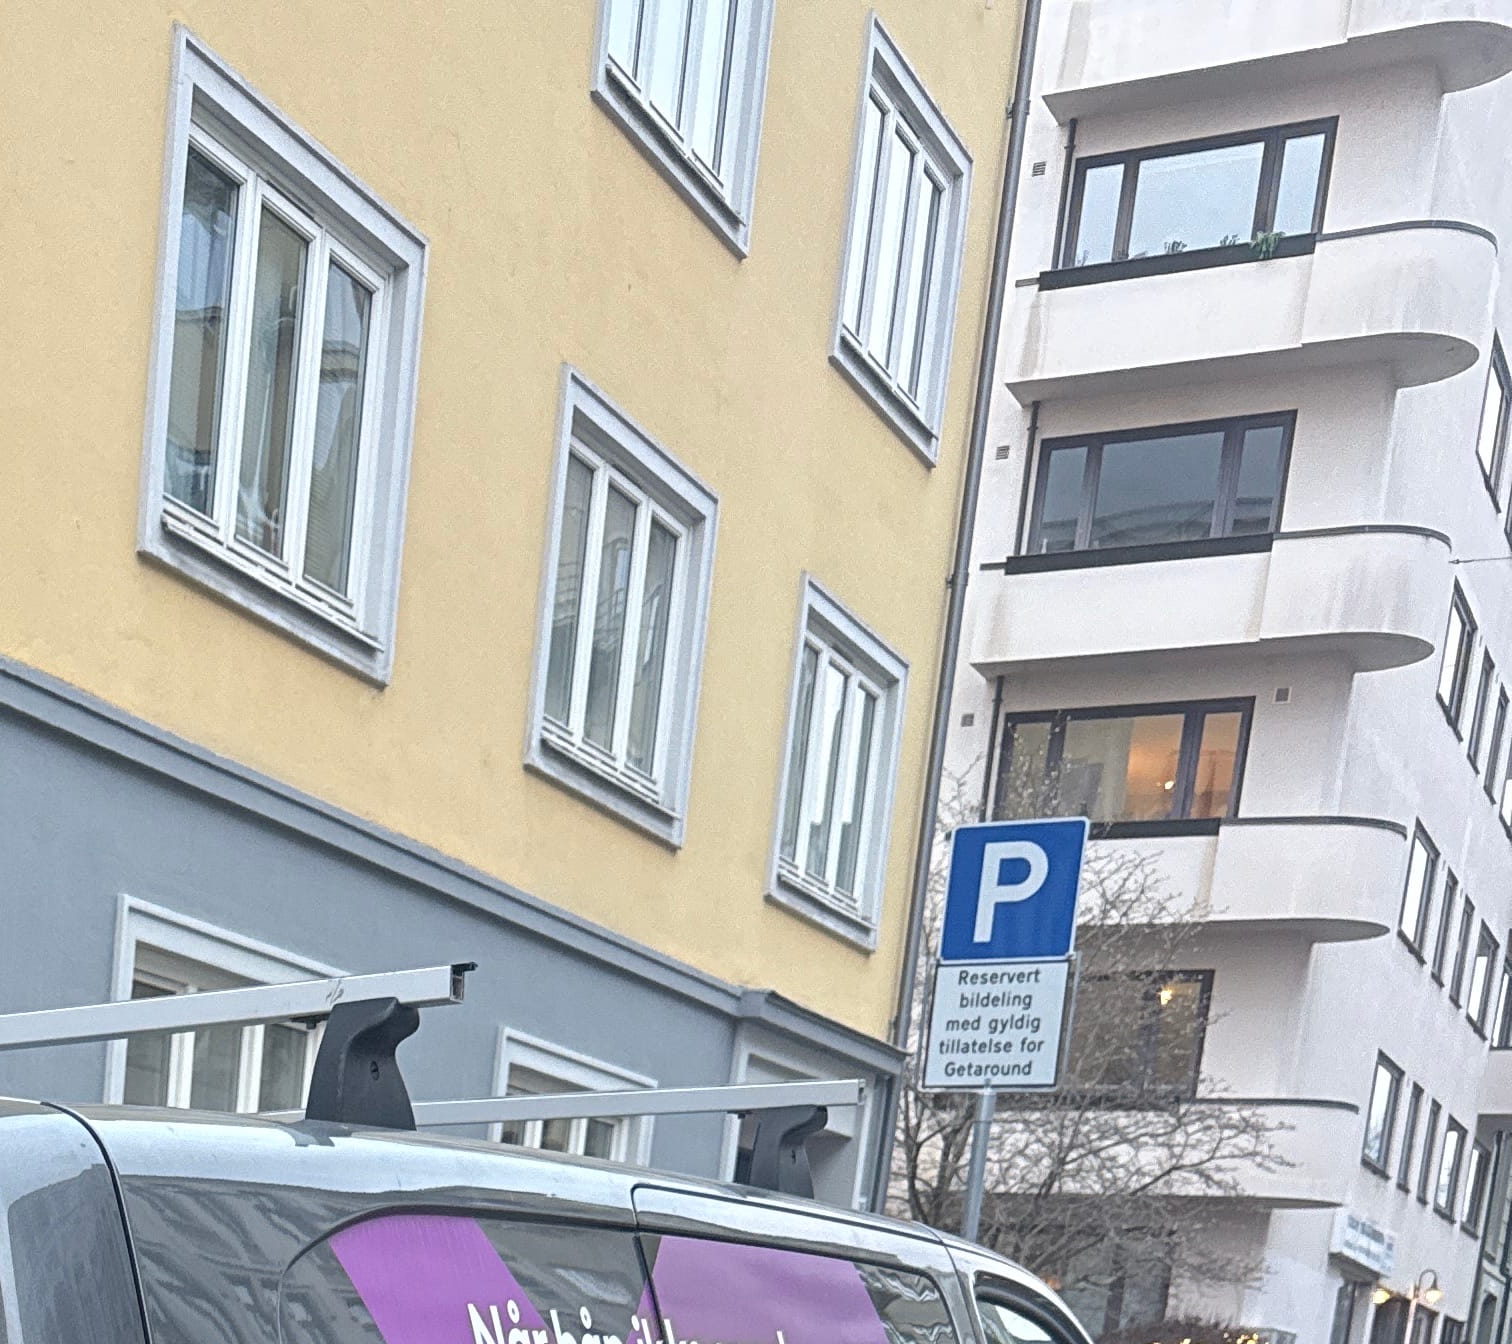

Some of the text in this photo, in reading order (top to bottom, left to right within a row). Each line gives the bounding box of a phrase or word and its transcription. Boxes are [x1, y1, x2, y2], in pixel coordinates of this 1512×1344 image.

[973, 840, 1048, 943] P
[958, 969, 1041, 986] Reservert
[959, 992, 1033, 1010] bildeling
[945, 1014, 1041, 1033] med gyldig
[939, 1038, 1045, 1055] tillatelse for
[944, 1061, 1032, 1077] Getaround
